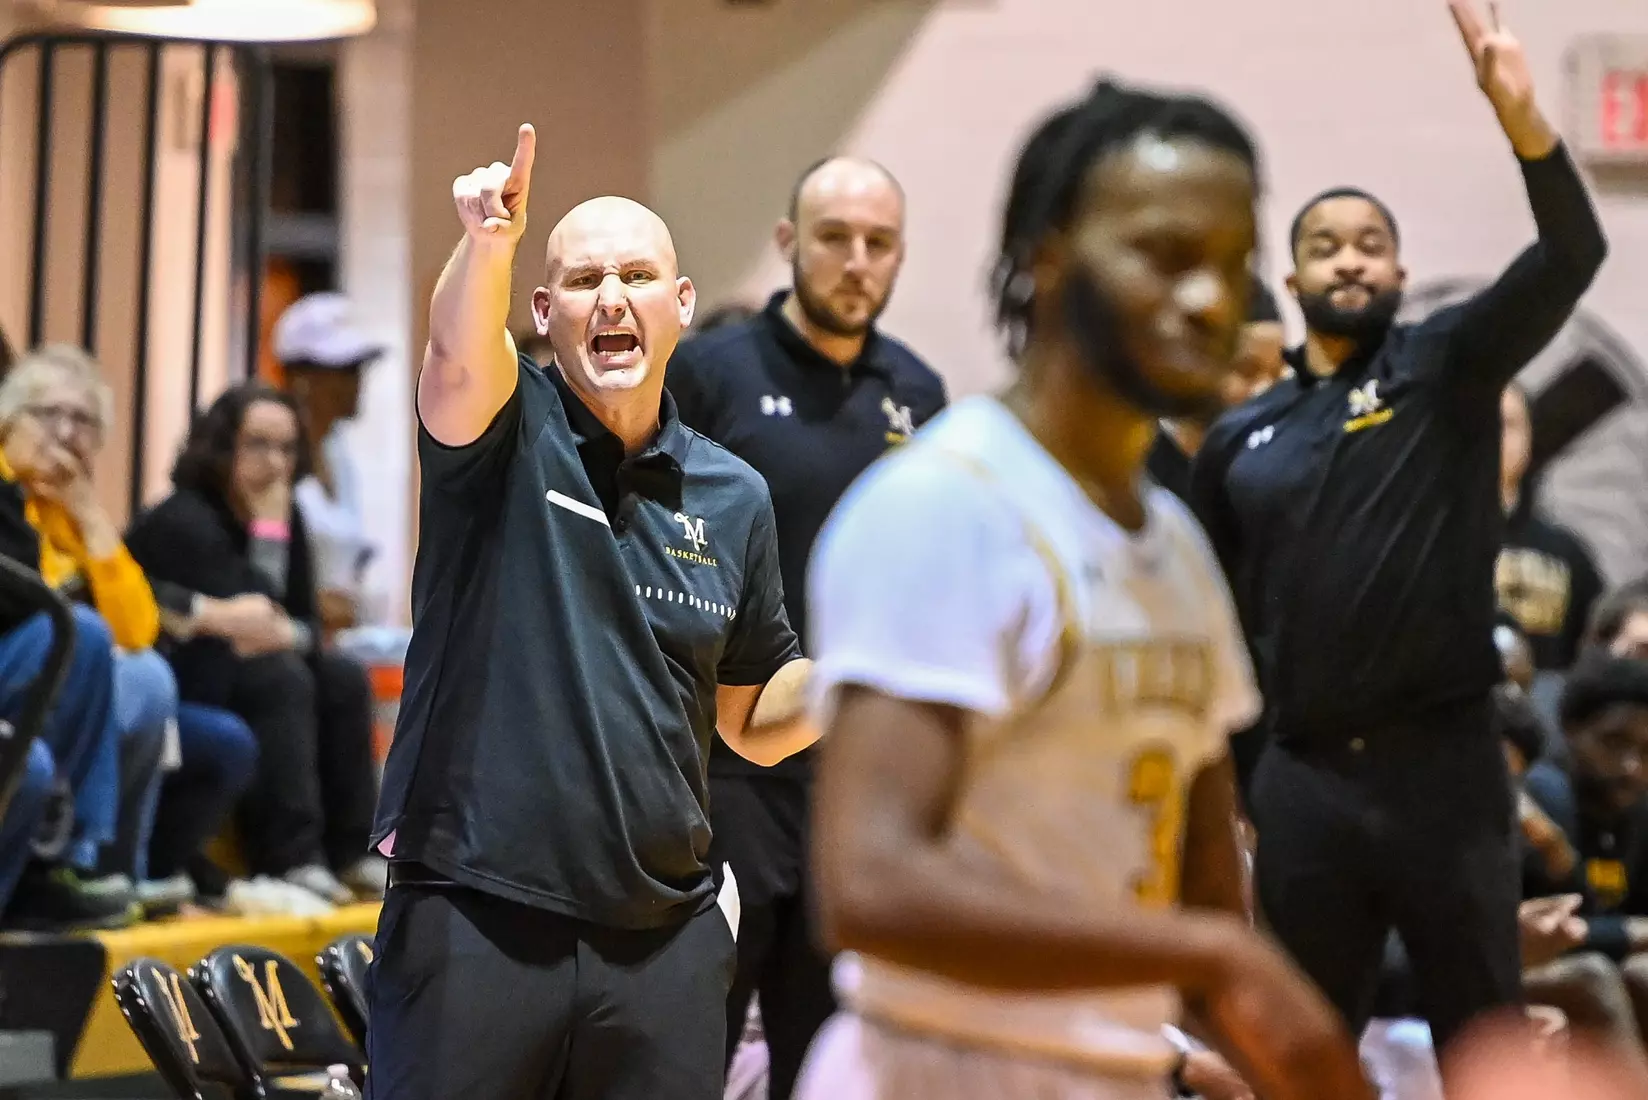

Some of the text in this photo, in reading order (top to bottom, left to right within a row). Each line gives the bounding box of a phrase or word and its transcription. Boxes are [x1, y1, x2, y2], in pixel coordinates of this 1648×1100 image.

[674, 511, 708, 551] M
[665, 546, 718, 567] BASKETBALL
[232, 953, 299, 1050] M
